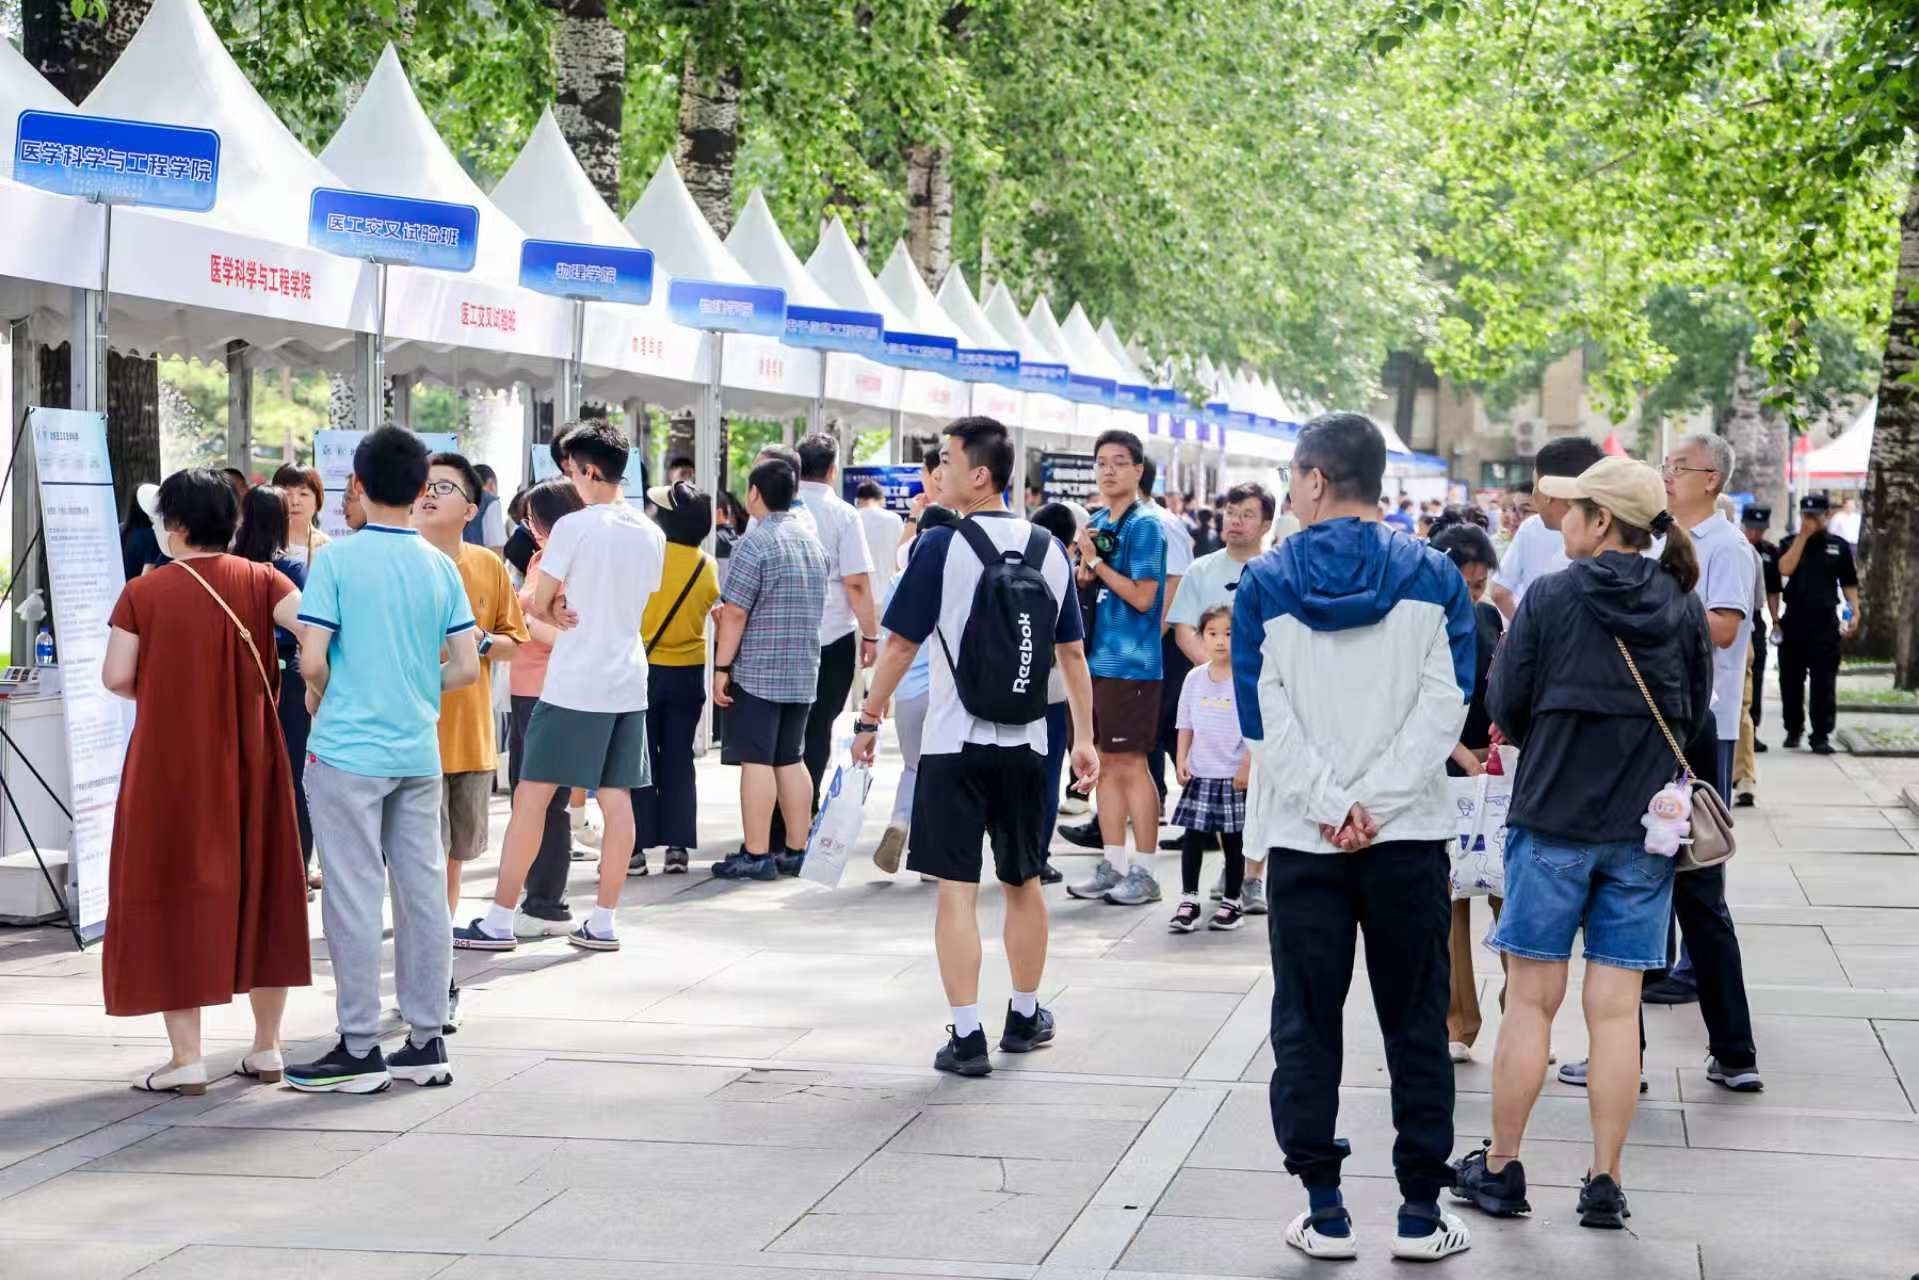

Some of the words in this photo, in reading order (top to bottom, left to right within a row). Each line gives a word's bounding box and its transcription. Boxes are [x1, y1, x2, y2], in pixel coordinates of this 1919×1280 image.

[20, 139, 212, 182] 医学科学与工程学院
[327, 213, 459, 247] 医工交叉试验班
[210, 254, 312, 300] 医学科学与工程学院
[1012, 612, 1033, 694] Reebok
